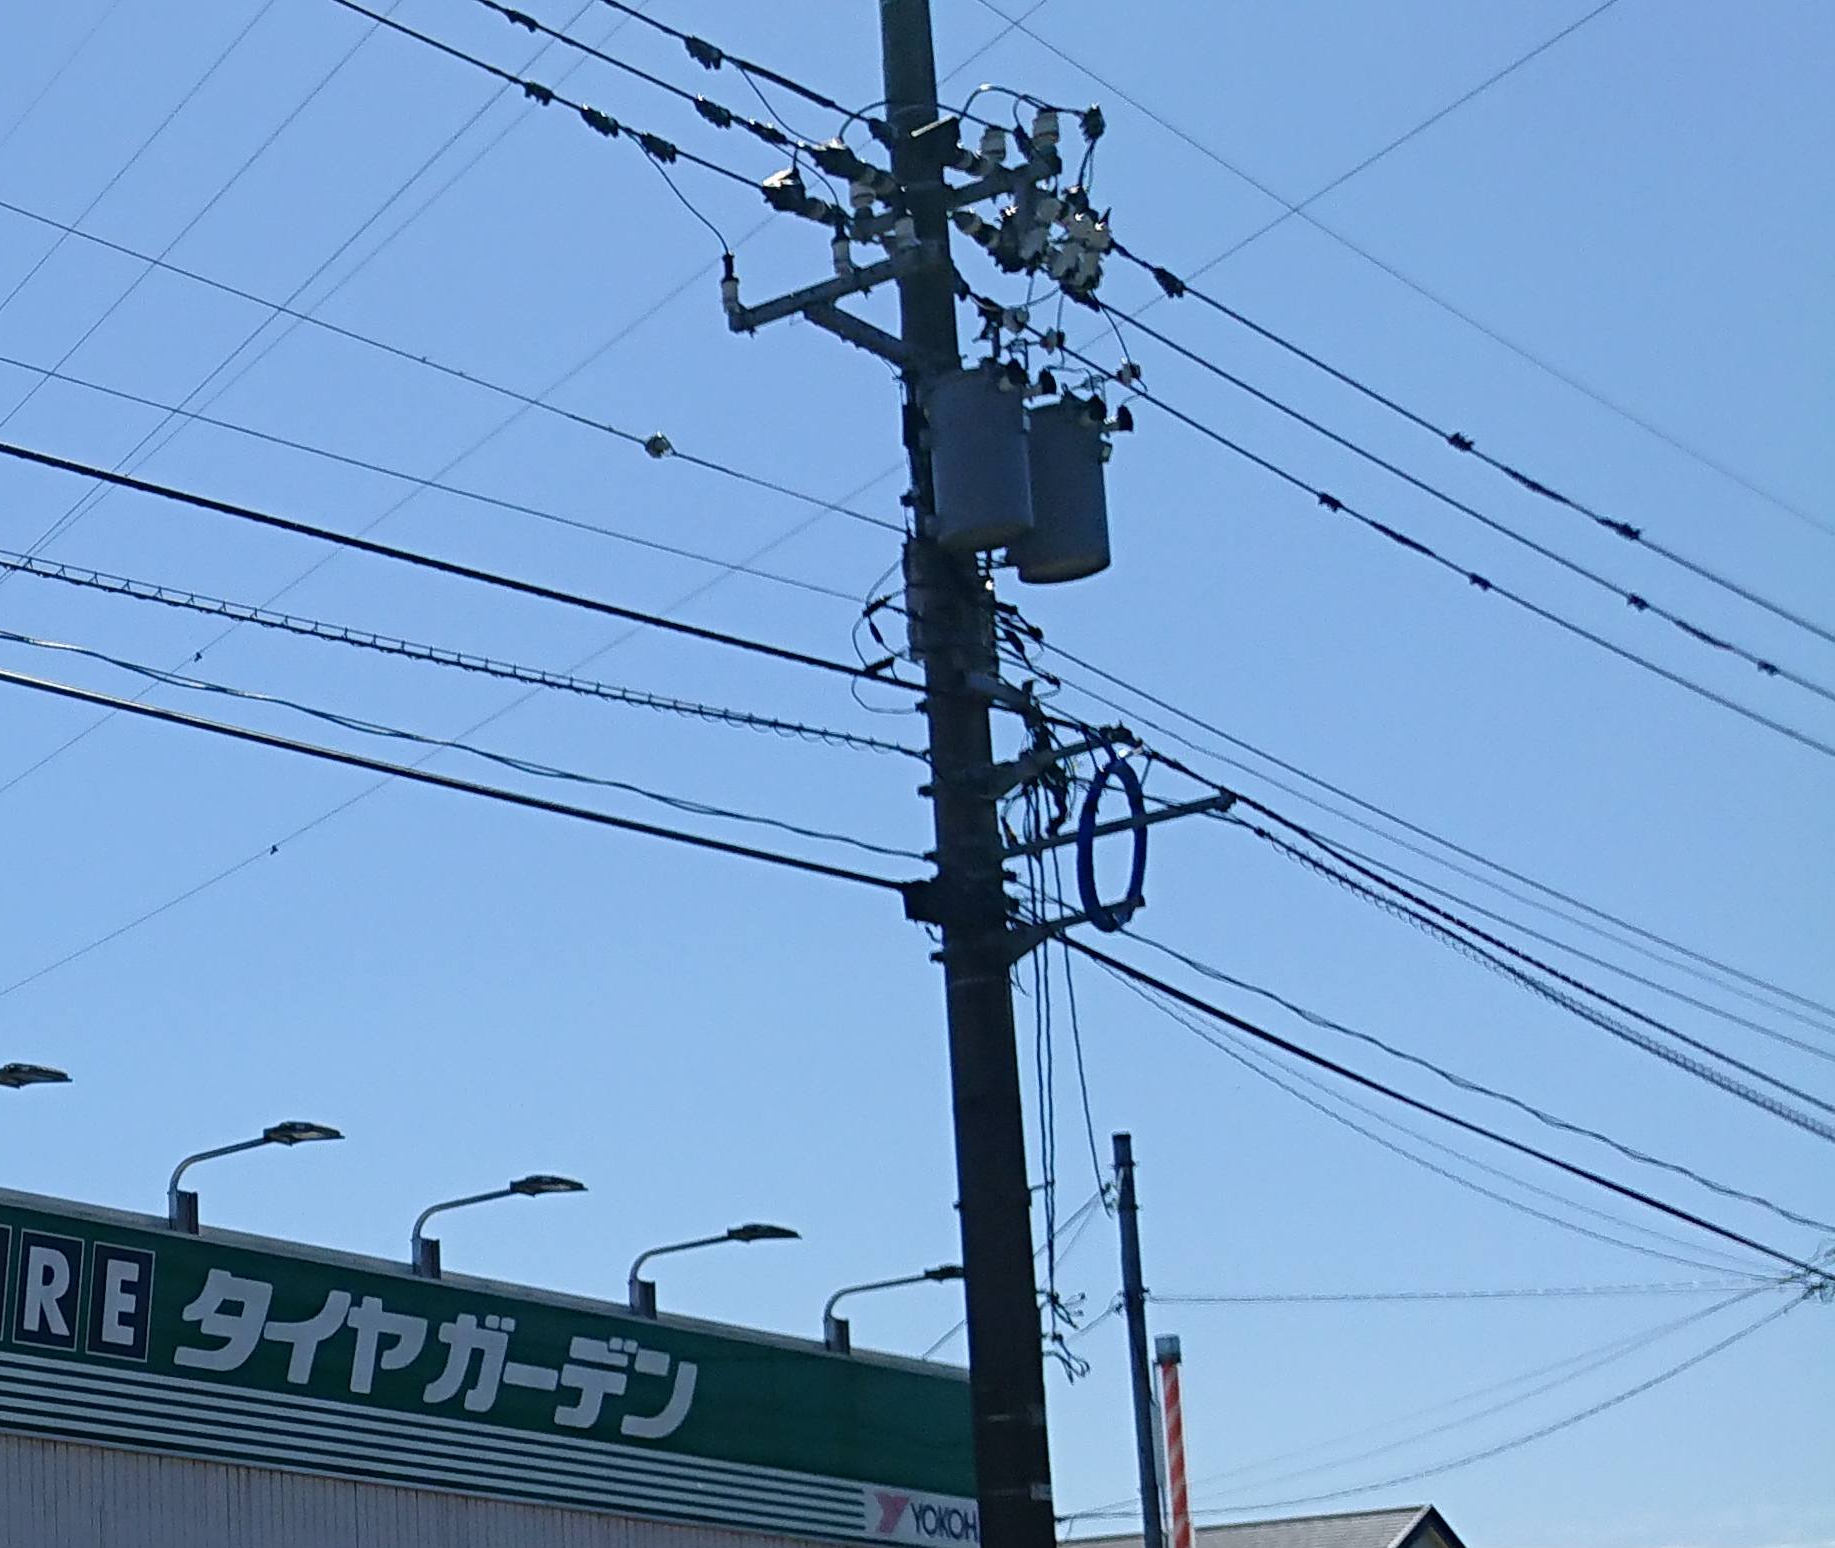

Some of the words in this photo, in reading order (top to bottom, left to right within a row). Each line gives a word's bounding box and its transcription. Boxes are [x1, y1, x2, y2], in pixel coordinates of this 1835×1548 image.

[174, 1268, 697, 1439] タイヤガーデン
